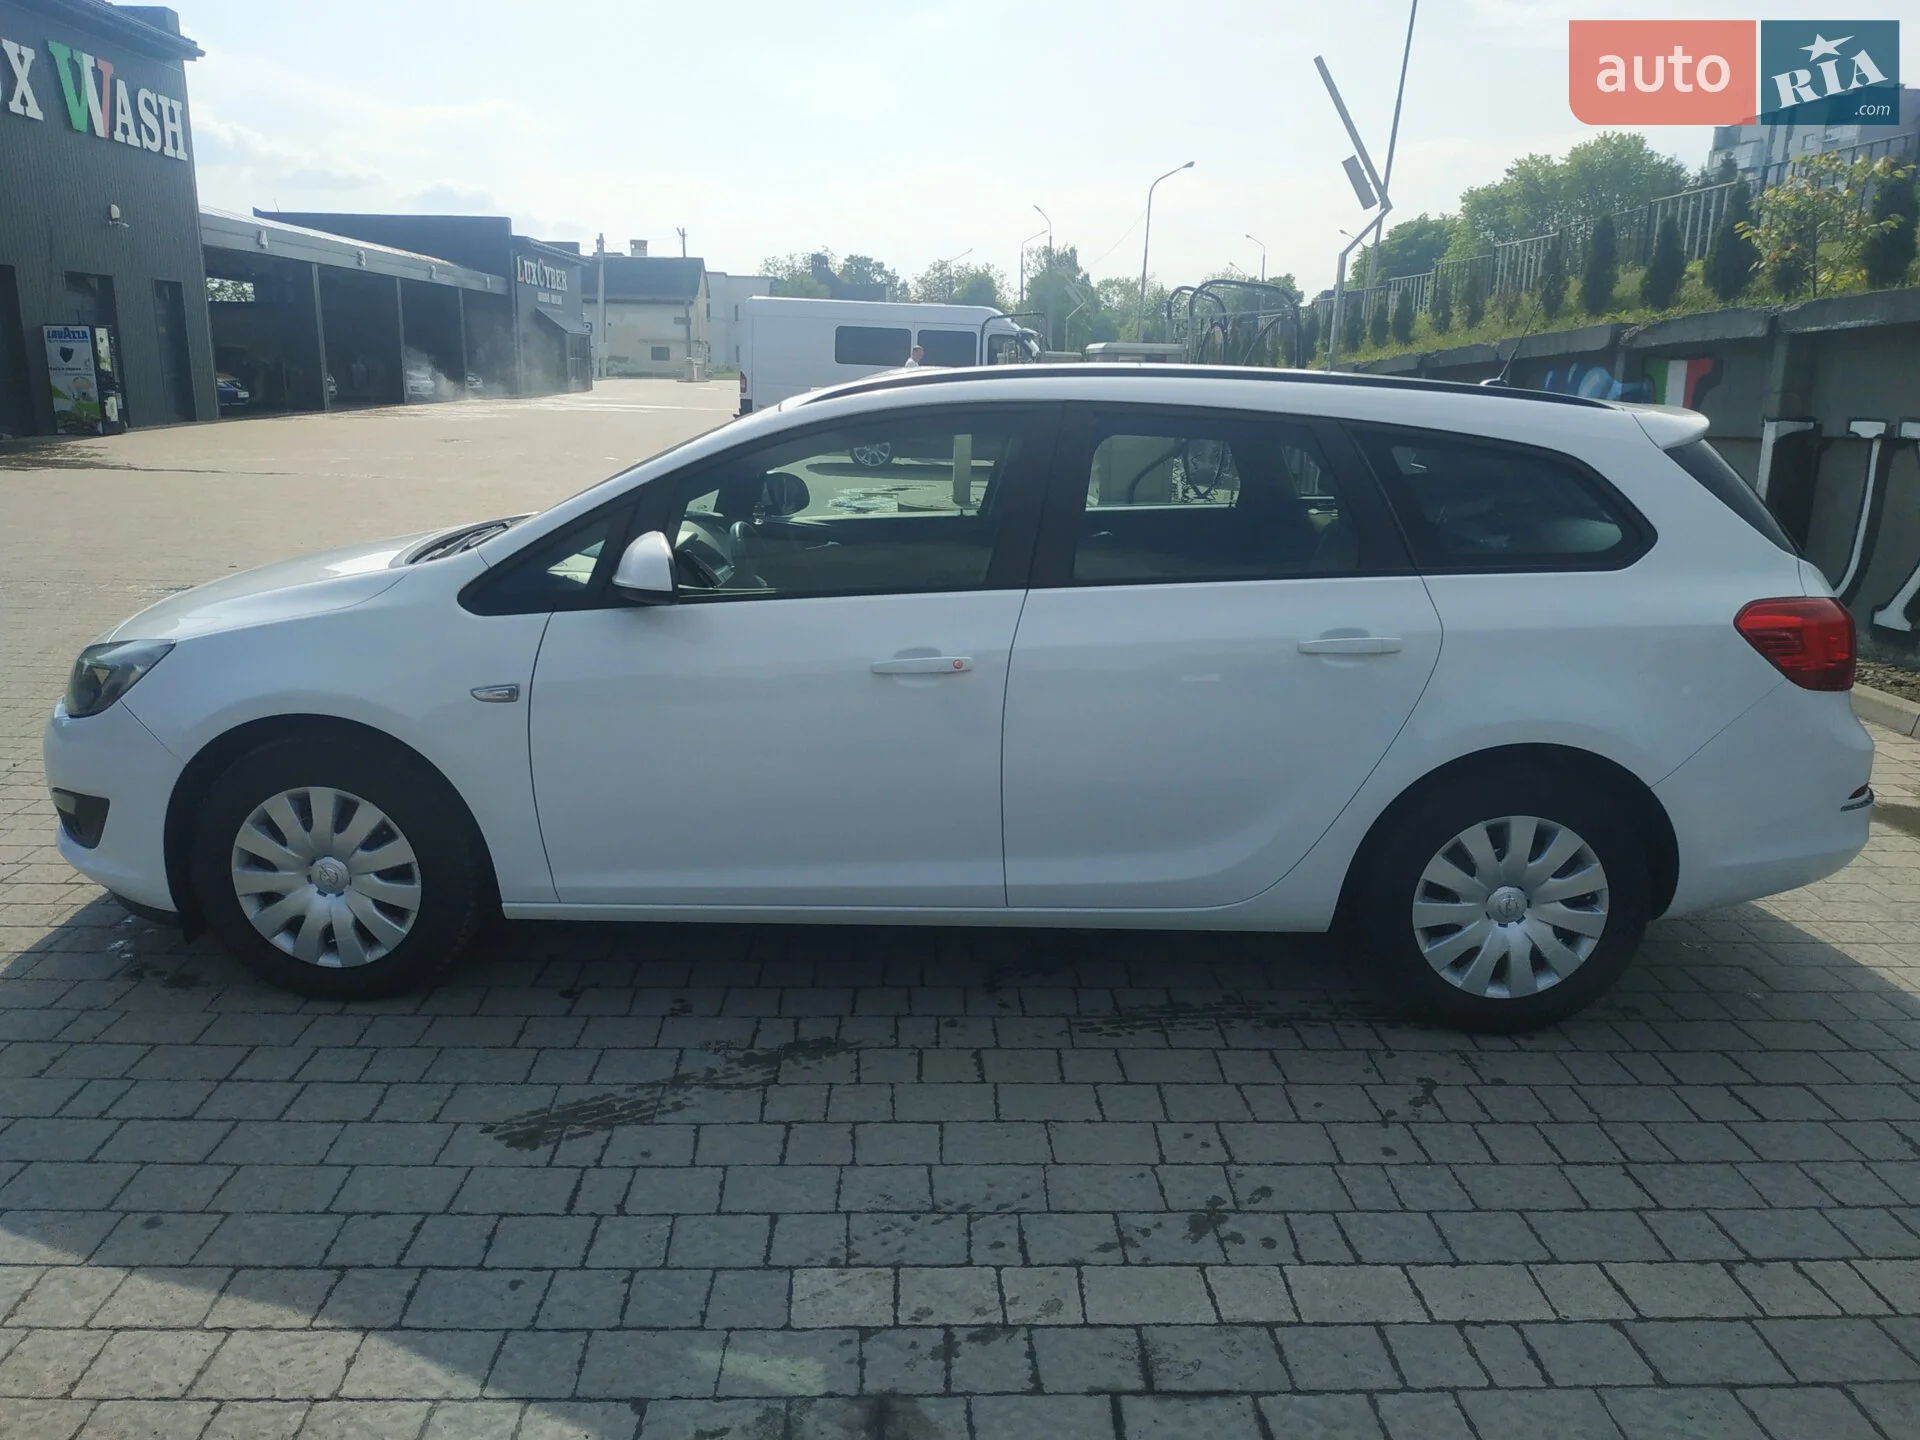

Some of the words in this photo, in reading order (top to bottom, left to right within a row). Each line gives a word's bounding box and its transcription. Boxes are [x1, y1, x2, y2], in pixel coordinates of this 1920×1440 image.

[0, 38, 44, 121] X
[47, 39, 188, 161] WASH
[259, 230, 269, 249] 4
[47, 327, 89, 339] LAVAZZA
